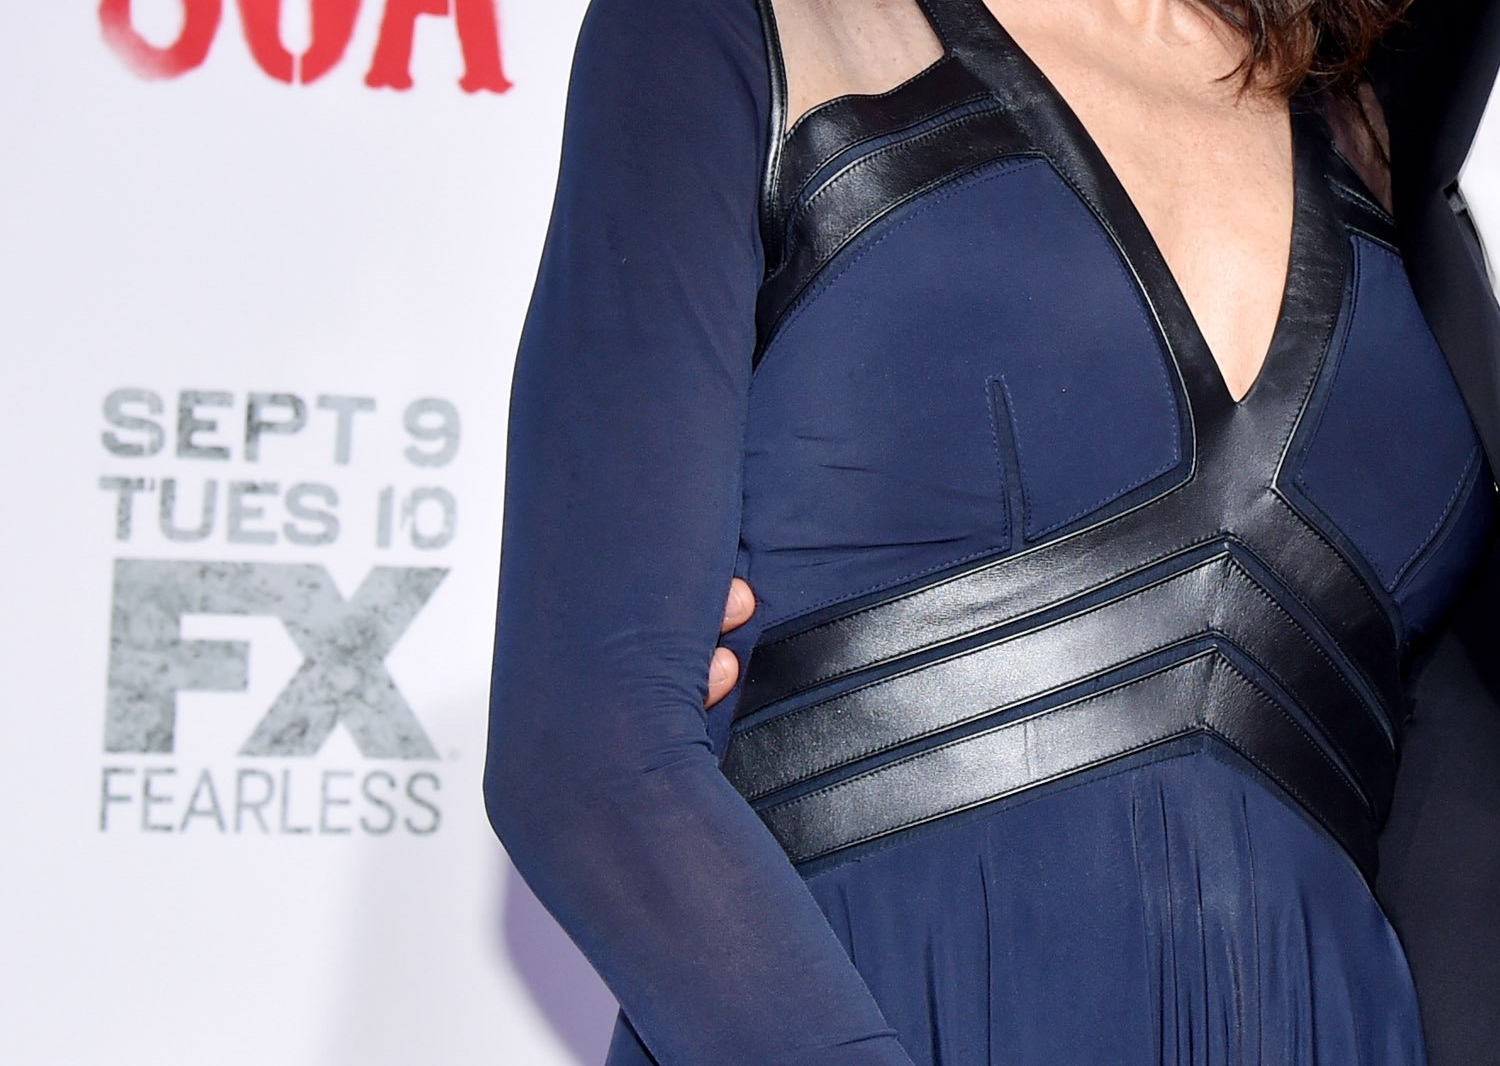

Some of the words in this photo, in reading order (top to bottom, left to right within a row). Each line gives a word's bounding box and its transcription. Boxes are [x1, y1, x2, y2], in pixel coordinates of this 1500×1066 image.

[101, 387, 376, 466] SEPT
[402, 396, 461, 468] 9
[97, 475, 341, 547] TUES
[375, 484, 458, 552] 10
[104, 557, 452, 761] FX
[98, 766, 443, 837] FEARLESS
